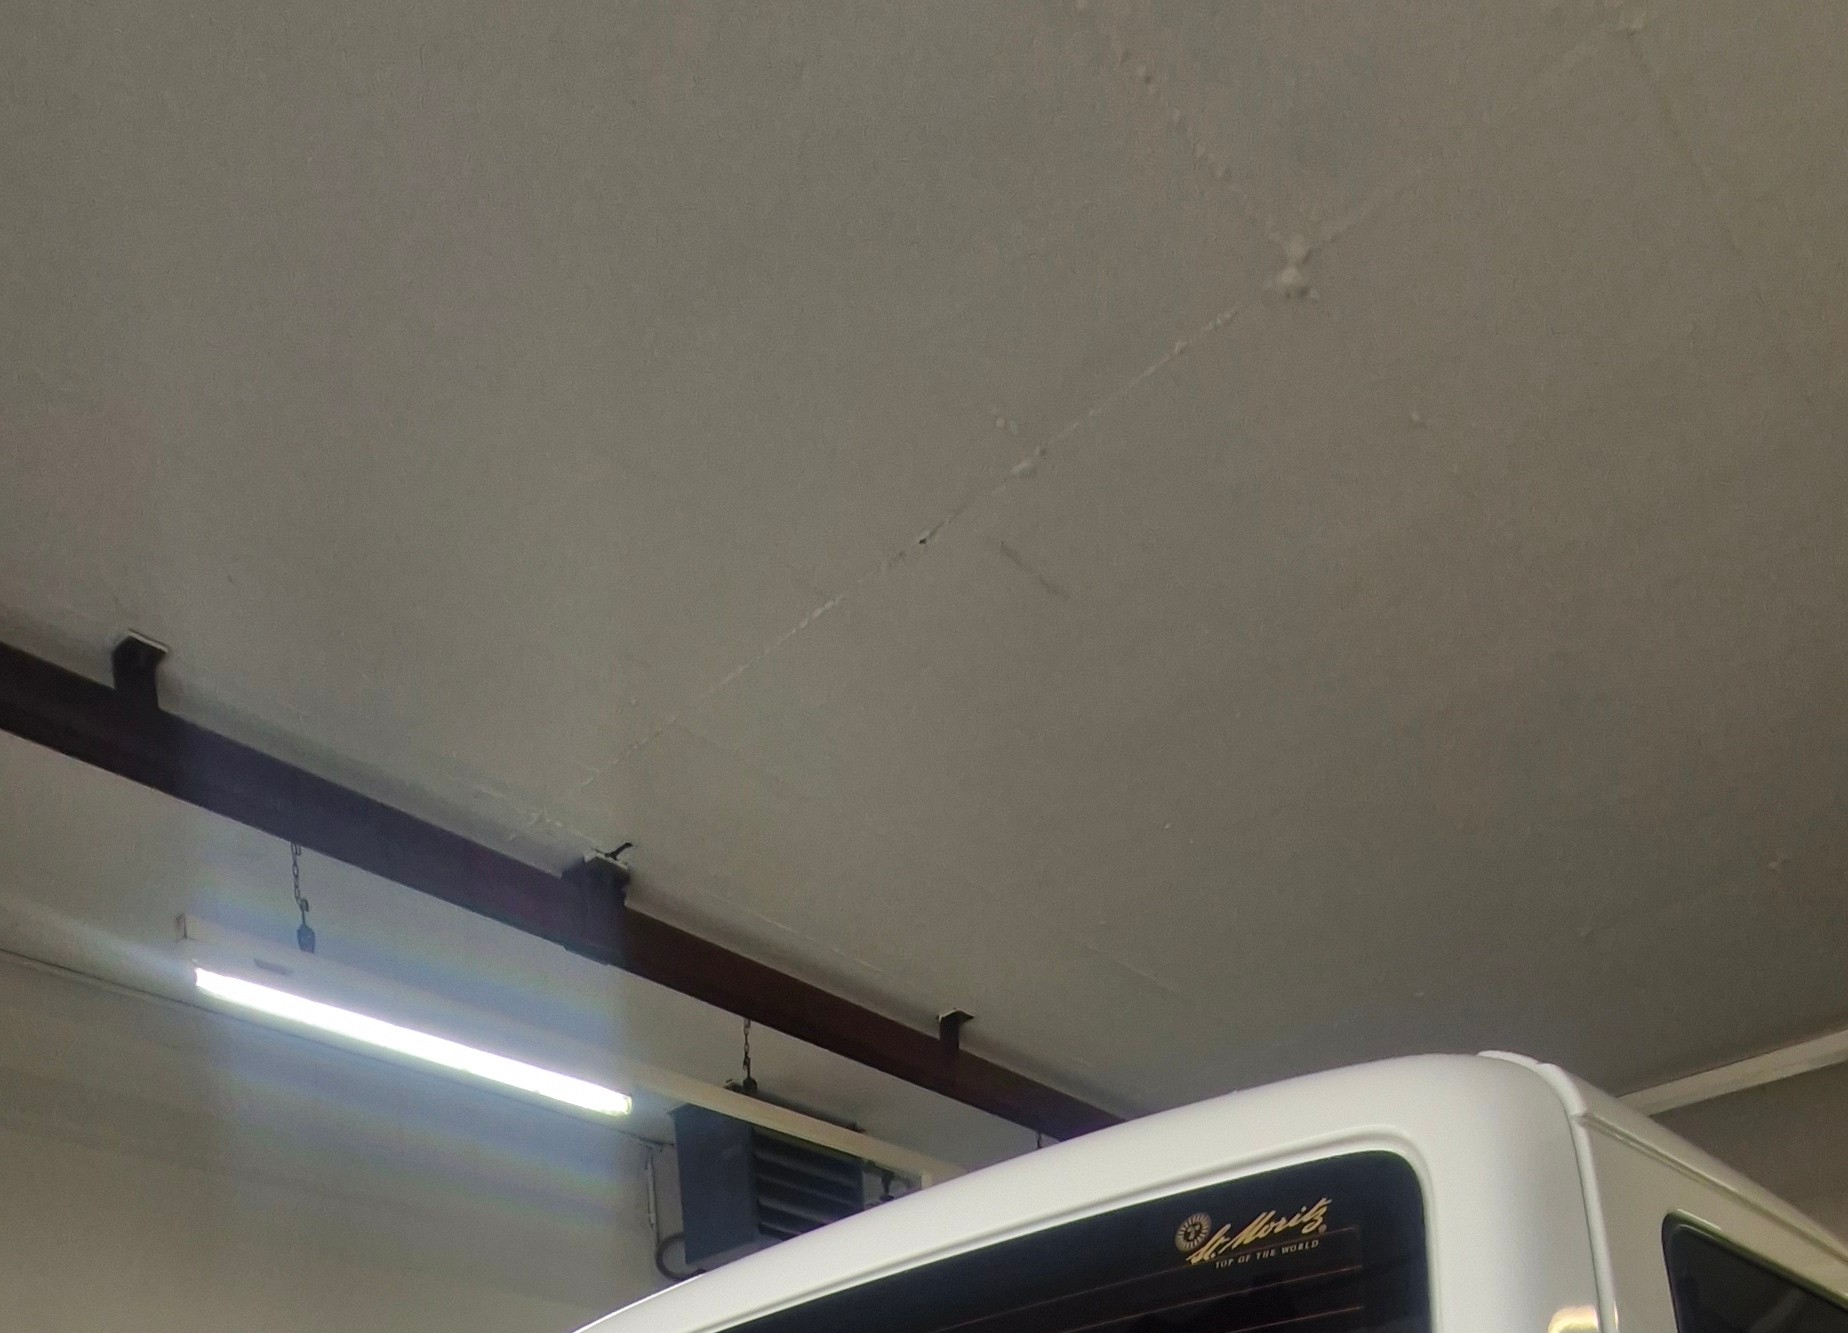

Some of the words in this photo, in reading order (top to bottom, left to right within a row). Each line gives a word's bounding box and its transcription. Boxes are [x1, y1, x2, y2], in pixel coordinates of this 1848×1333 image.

[1215, 1258, 1234, 1270] TOP
[1237, 1254, 1251, 1265] OF
[1256, 1248, 1277, 1261] THE
[1281, 1239, 1320, 1256] WORLD
